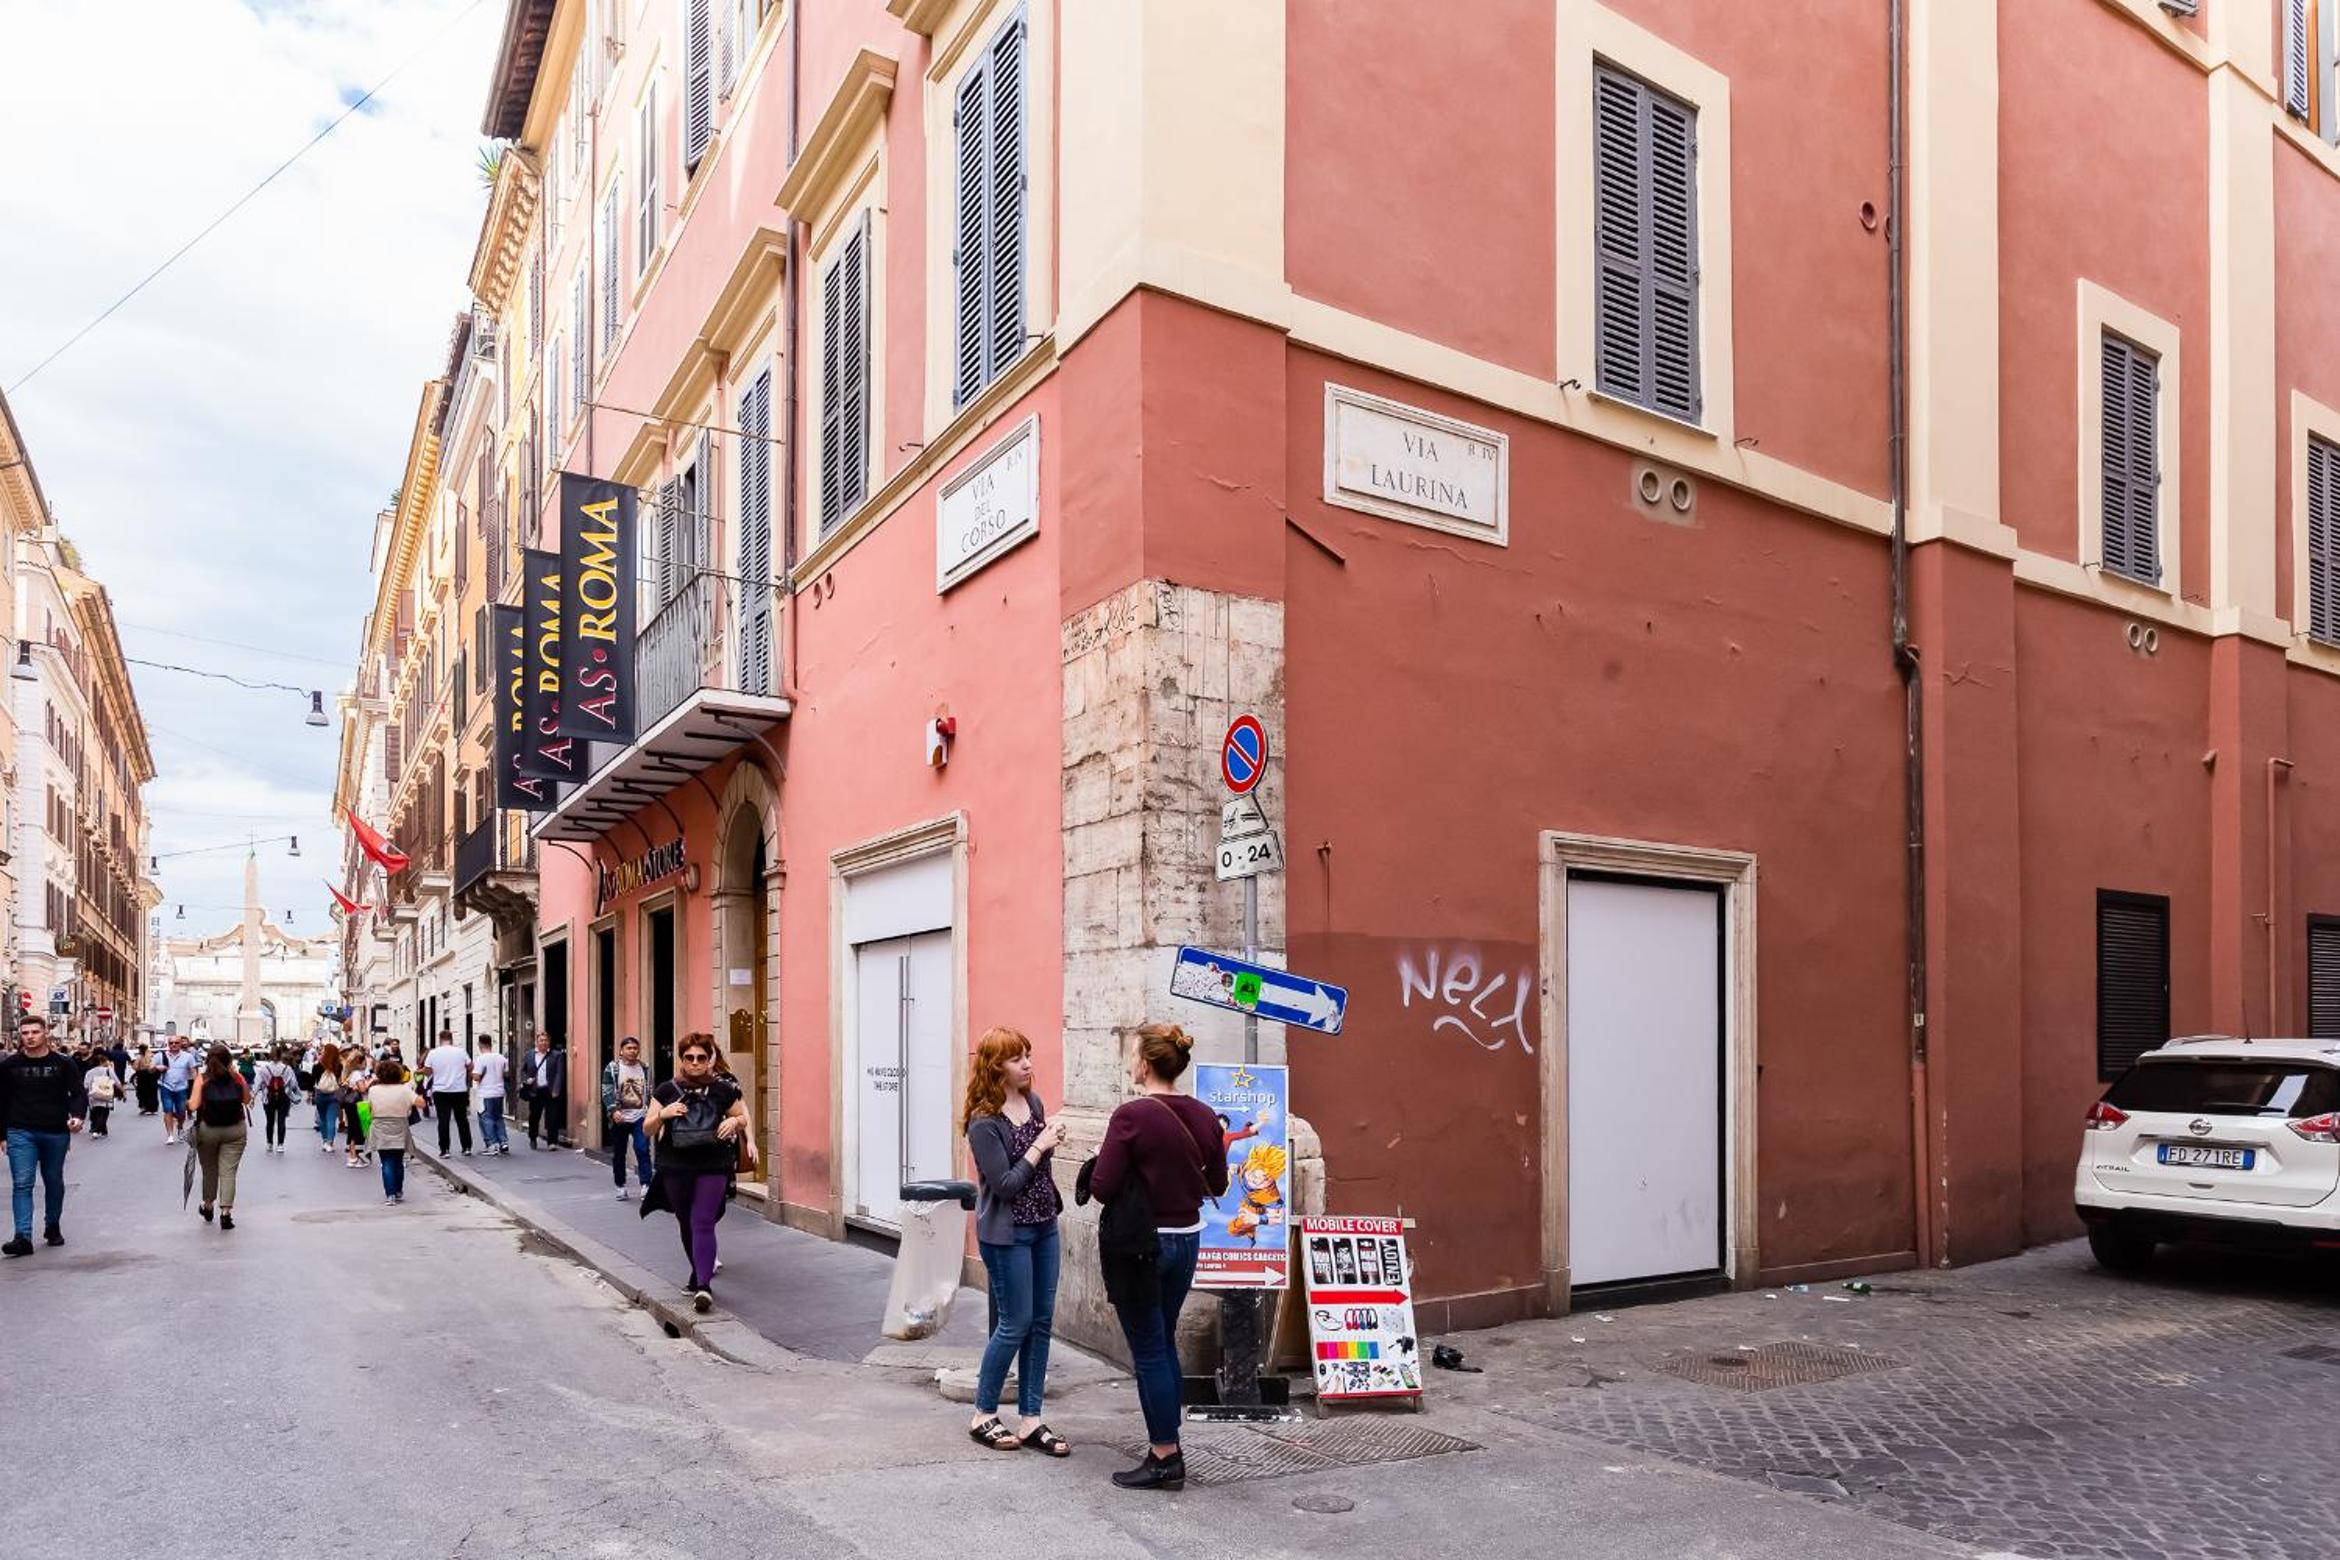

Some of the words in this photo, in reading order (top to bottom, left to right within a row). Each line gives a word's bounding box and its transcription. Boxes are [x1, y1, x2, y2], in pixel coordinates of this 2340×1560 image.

[1403, 431, 1438, 462] VIA
[971, 473, 994, 500] VIA
[1371, 464, 1468, 509] LAURINA
[961, 508, 1005, 552] CORSO
[578, 496, 619, 645] ROMA
[578, 667, 617, 730] AS
[1247, 843, 1271, 862] 24
[1210, 1090, 1276, 1109] Starshop
[1306, 1219, 1355, 1231] MOBILE
[1356, 1219, 1398, 1233] COVER
[1383, 1244, 1401, 1284] ENJOY
